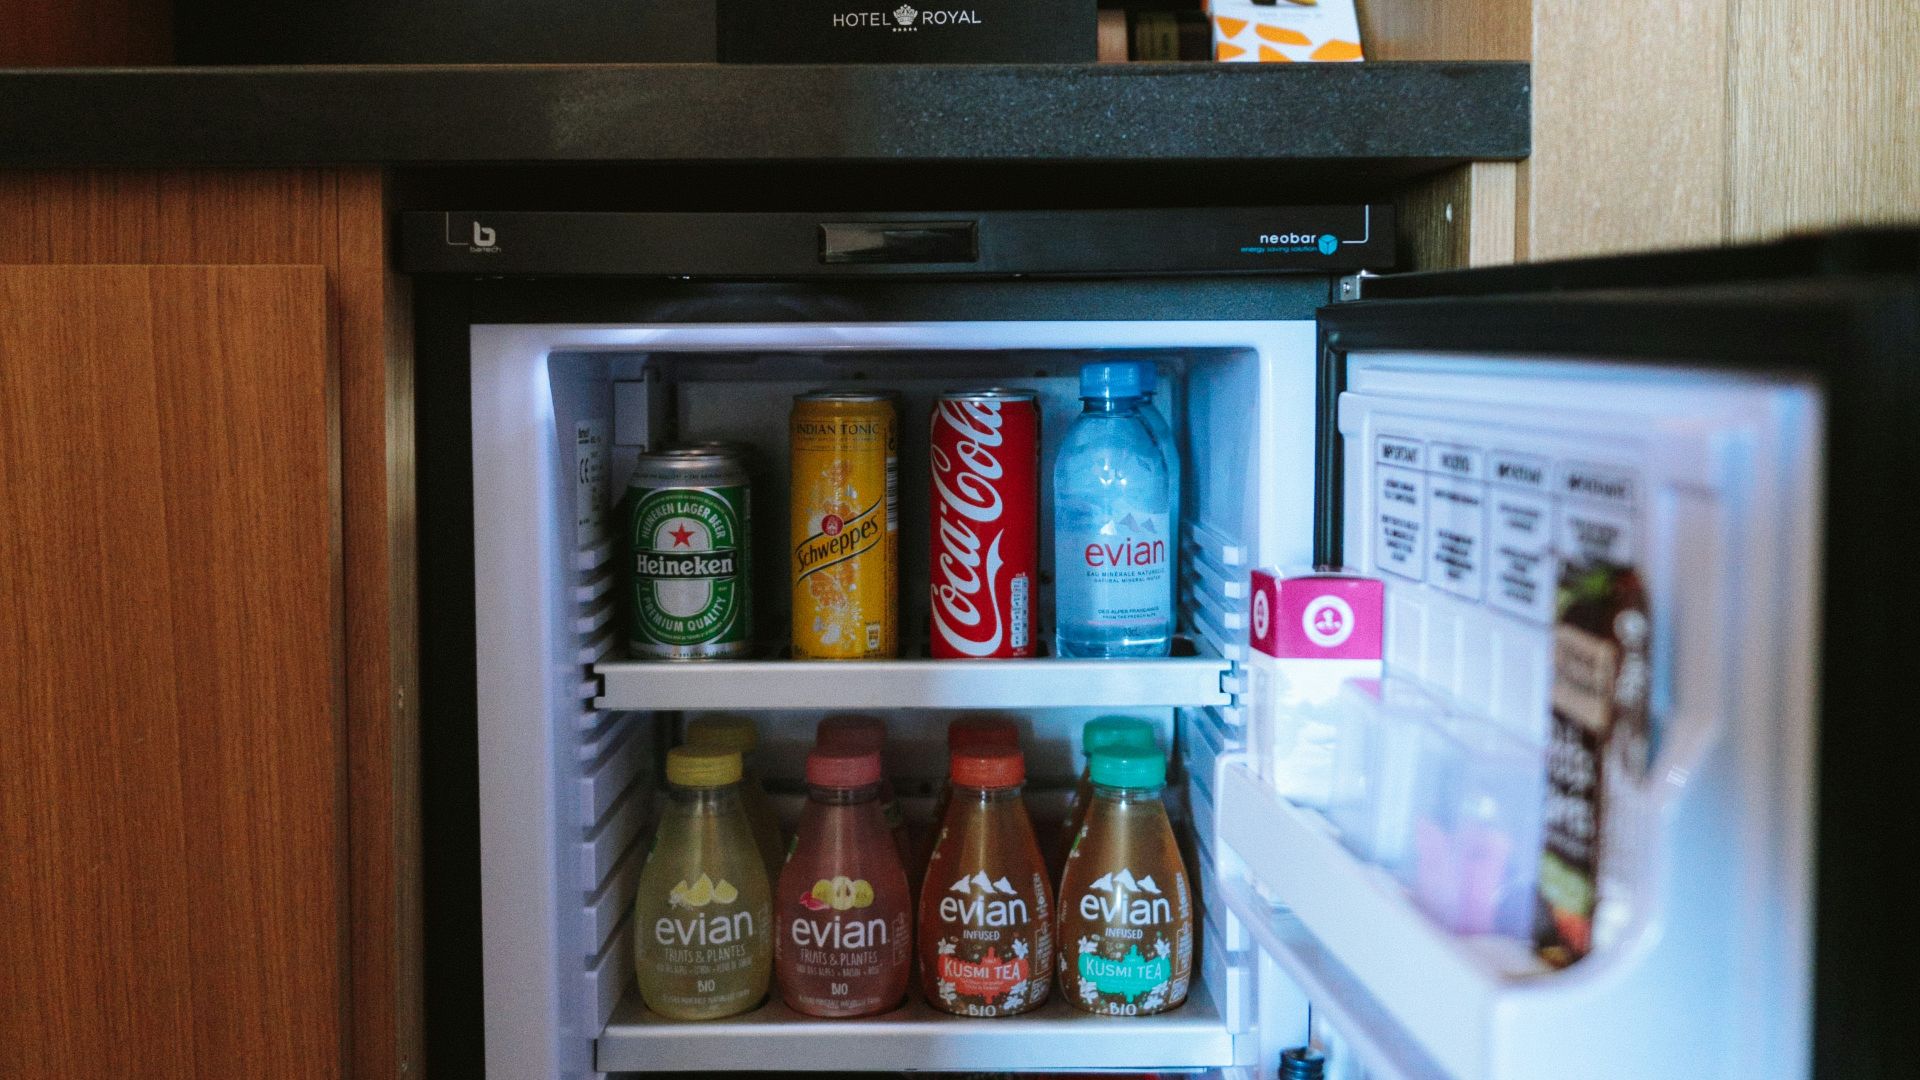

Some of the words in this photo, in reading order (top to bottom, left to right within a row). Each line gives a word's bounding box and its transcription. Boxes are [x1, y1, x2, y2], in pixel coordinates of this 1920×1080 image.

[833, 13, 892, 27] HOTEL
[922, 10, 982, 25] ROYAL
[1260, 232, 1316, 244] neobar
[797, 423, 836, 435] INDIAN
[840, 423, 880, 435] TONIC
[641, 502, 675, 539] HEINEKEN
[677, 502, 711, 519] LAGER
[708, 513, 727, 539] BEER
[931, 400, 1004, 657] Coca-Cola
[798, 514, 879, 573] Schweppes
[1084, 537, 1165, 567] evian
[637, 554, 734, 576] Heineken
[644, 596, 684, 632] PREMIUM
[687, 596, 727, 632] QUALITY
[940, 895, 1028, 926] evian
[1080, 894, 1171, 925] evian
[655, 911, 753, 945] evian
[791, 915, 887, 949] evian
[963, 930, 1001, 941] INFUSED
[1105, 928, 1144, 939] INFUSED
[665, 947, 693, 963] FRUITS
[695, 951, 704, 963] &
[707, 945, 746, 963] PLANTES
[800, 948, 828, 965] FRUITS
[829, 953, 838, 966] &
[840, 951, 878, 966] PLANTES
[944, 957, 990, 979] KUSMI
[995, 961, 1021, 980] TEA
[1086, 957, 1133, 977] KUSMI
[1137, 962, 1162, 980] TEA
[697, 979, 716, 992] BIO
[831, 982, 849, 996] BIO
[968, 1003, 997, 1017] BIO
[1110, 1002, 1137, 1016] BIO
